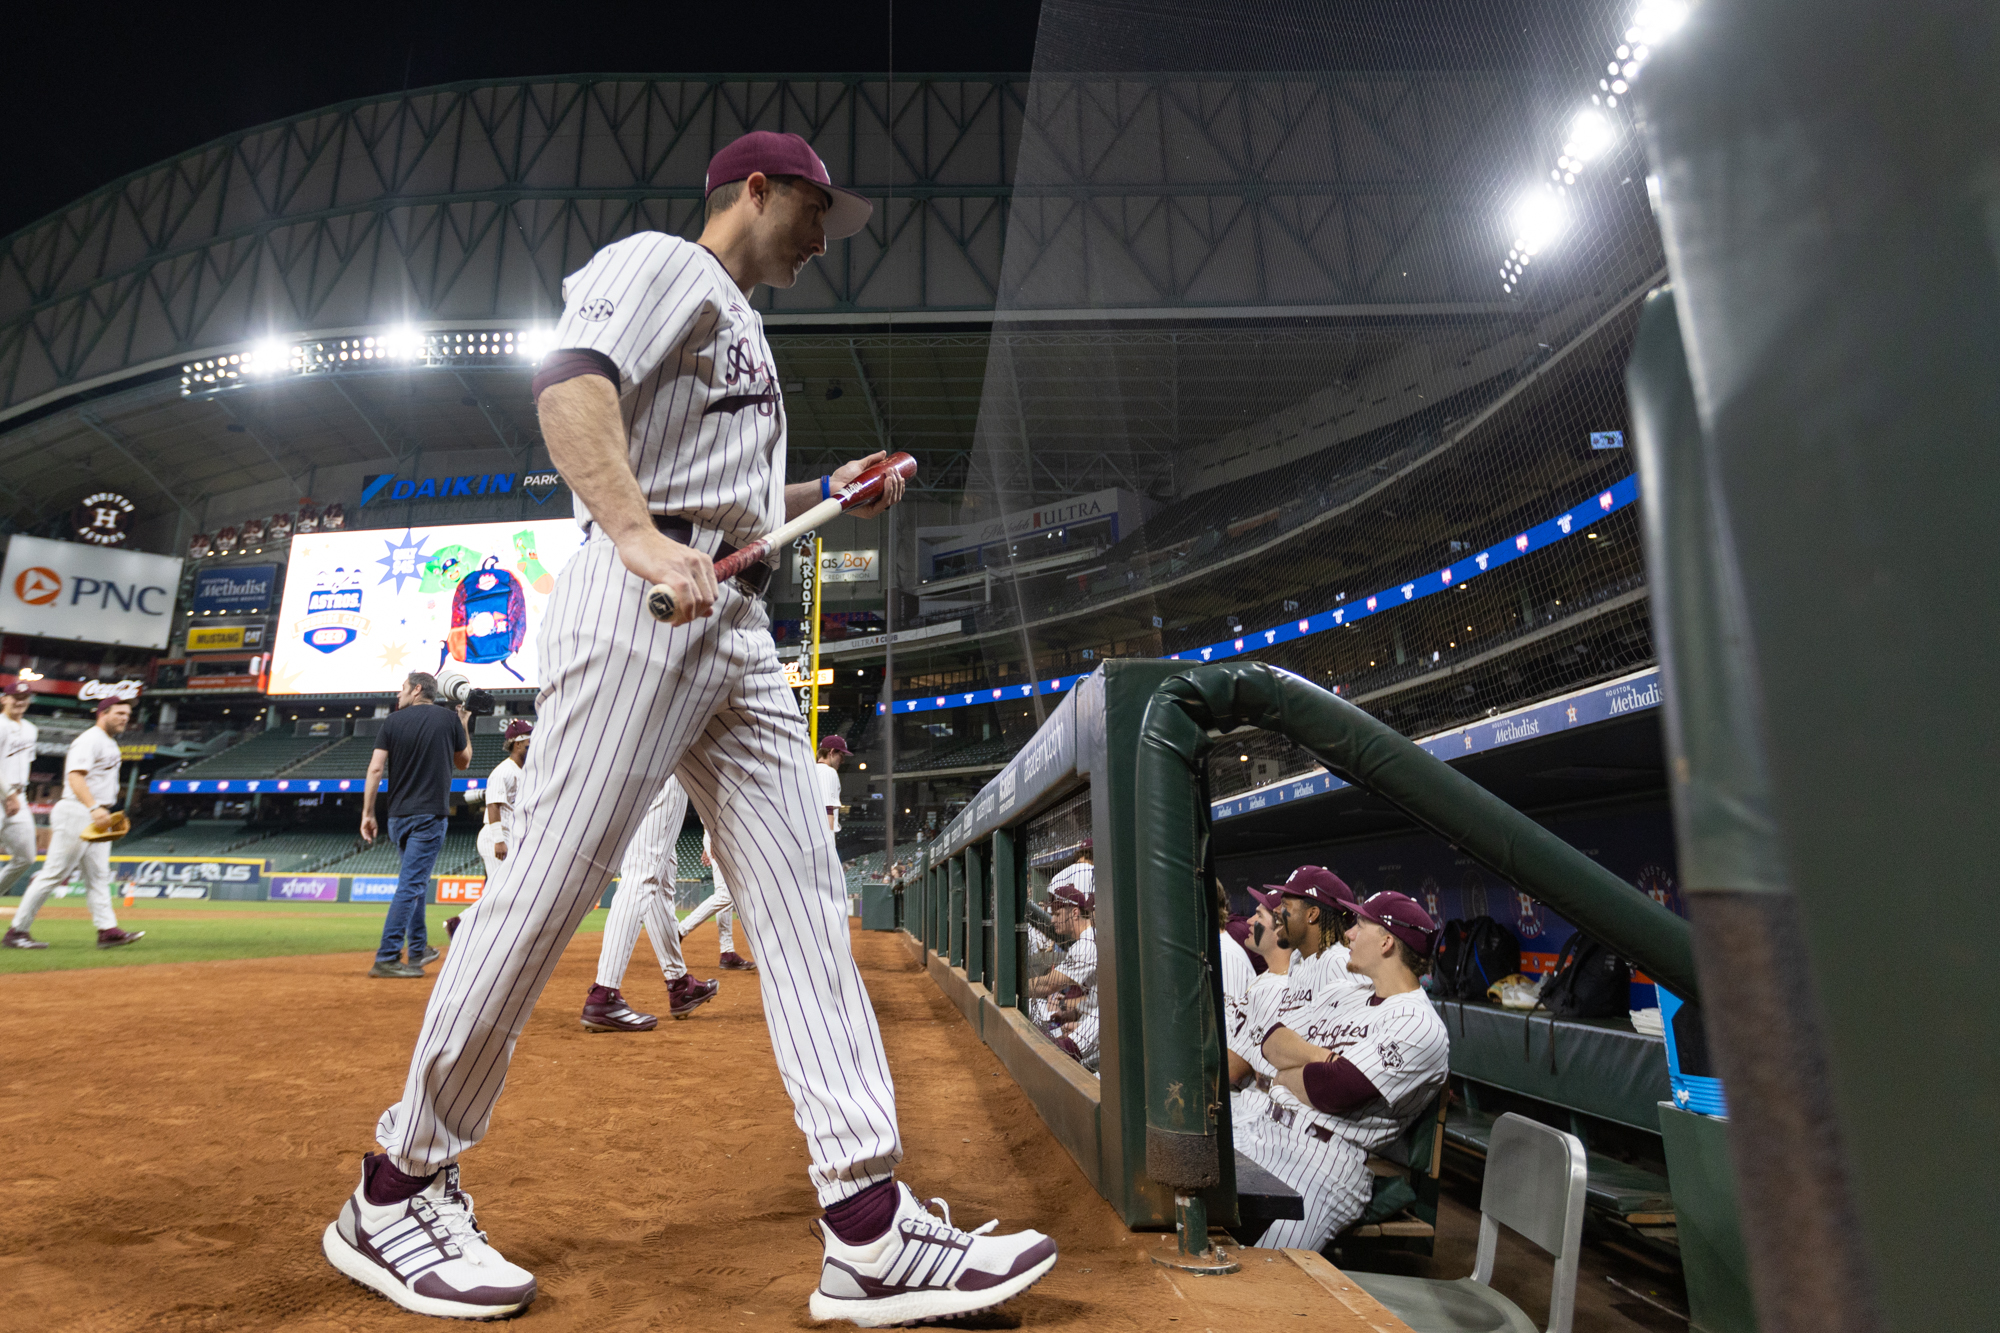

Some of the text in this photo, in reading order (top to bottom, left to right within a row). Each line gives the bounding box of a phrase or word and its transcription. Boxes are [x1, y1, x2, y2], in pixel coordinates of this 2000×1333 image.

[391, 473, 559, 499] DAIKIN PARK
[83, 492, 135, 512] HOUSTON
[93, 508, 119, 528] H
[1044, 501, 1101, 525] ULTRA
[79, 527, 126, 544] ASTROS
[844, 553, 872, 572] Bay
[71, 576, 166, 615] PNC
[199, 579, 266, 597] Methodist
[197, 631, 261, 643] MUSTANG CAT
[852, 638, 875, 648] ULTRA
[1605, 685, 1631, 697] HOUSTON
[1494, 718, 1540, 744] Methodist
[1637, 865, 1673, 888] HOUSTON
[280, 878, 328, 898] xfinity
[366, 884, 399, 895] HON
[1517, 919, 1541, 936] ASTROS
[1308, 1018, 1369, 1043] Aggies
